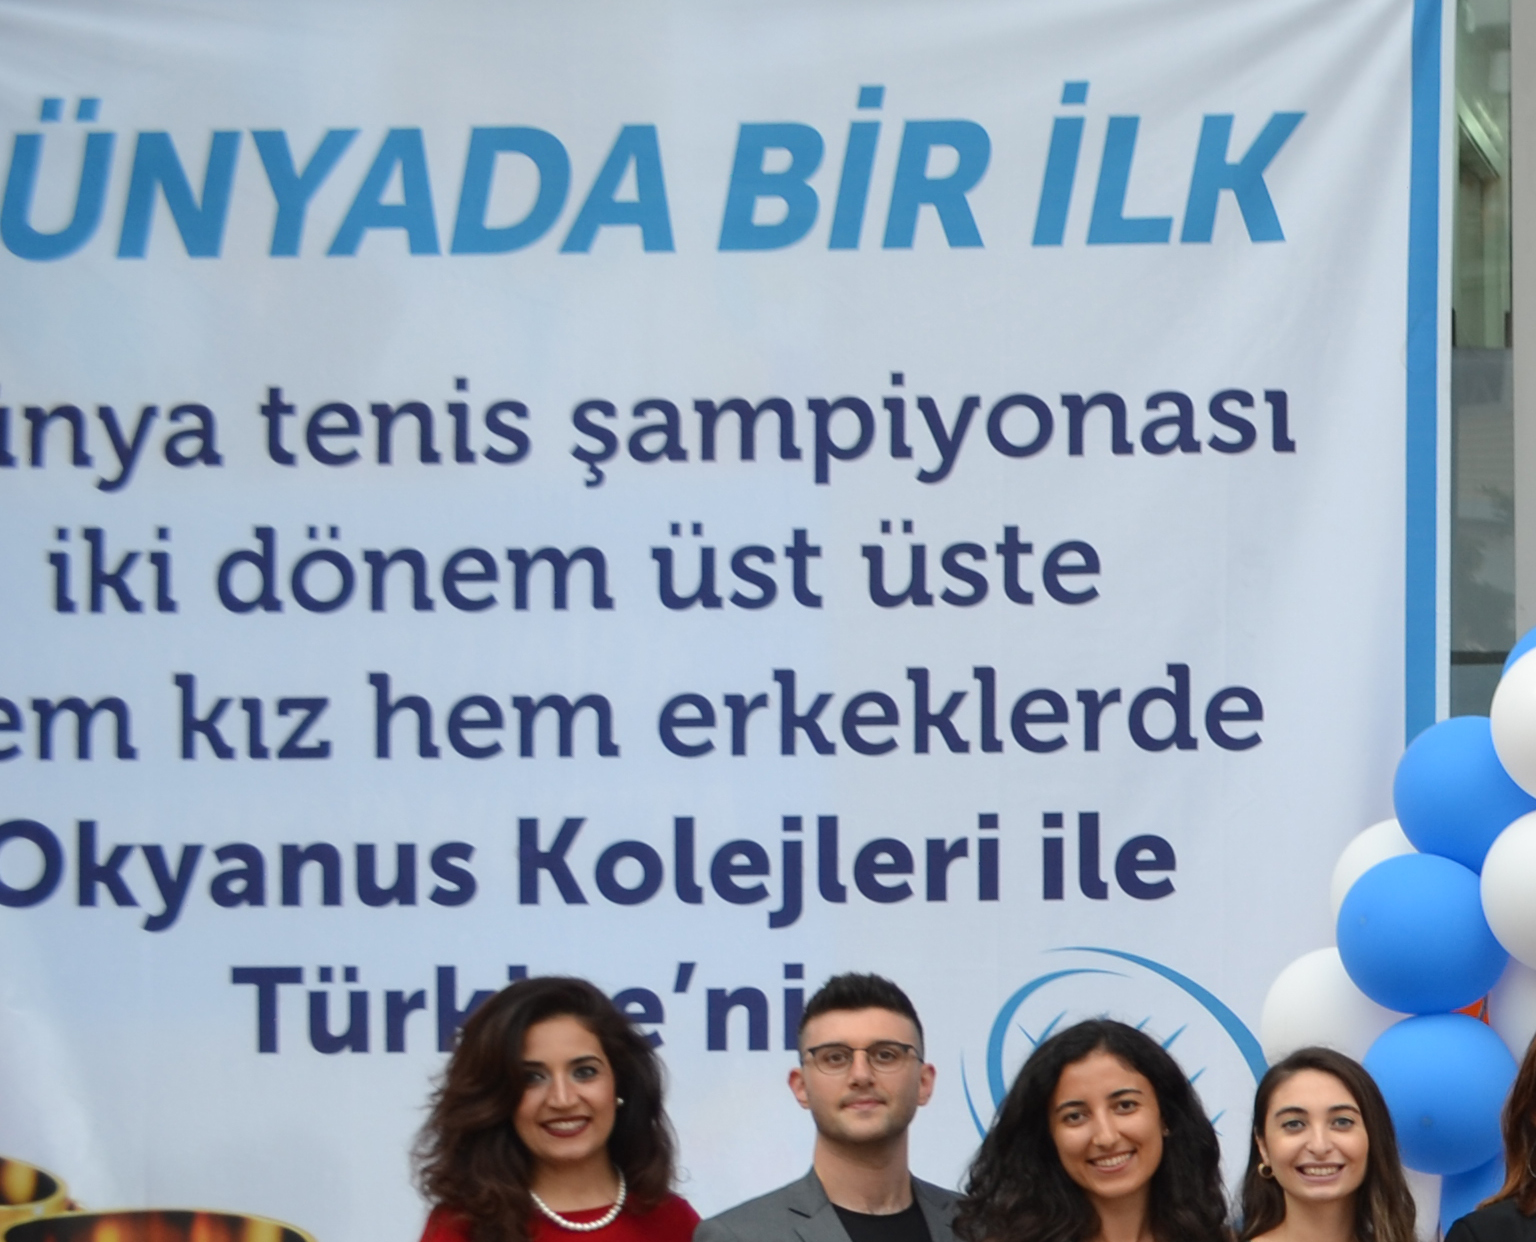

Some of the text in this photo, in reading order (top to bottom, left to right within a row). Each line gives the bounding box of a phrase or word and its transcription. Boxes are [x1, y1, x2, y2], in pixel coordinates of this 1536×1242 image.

[0, 81, 1307, 263] ÜNYADA BİR İLK
[0, 371, 1297, 494] nya tenis şampiyonası
[46, 518, 1102, 615] iki dönem üst üste
[172, 671, 333, 761] kız
[366, 671, 621, 761] hem
[656, 661, 1265, 760] erkeklerde
[0, 810, 1178, 934] Okyanus Kolejleri ile
[229, 961, 806, 1057] Türke'ni
